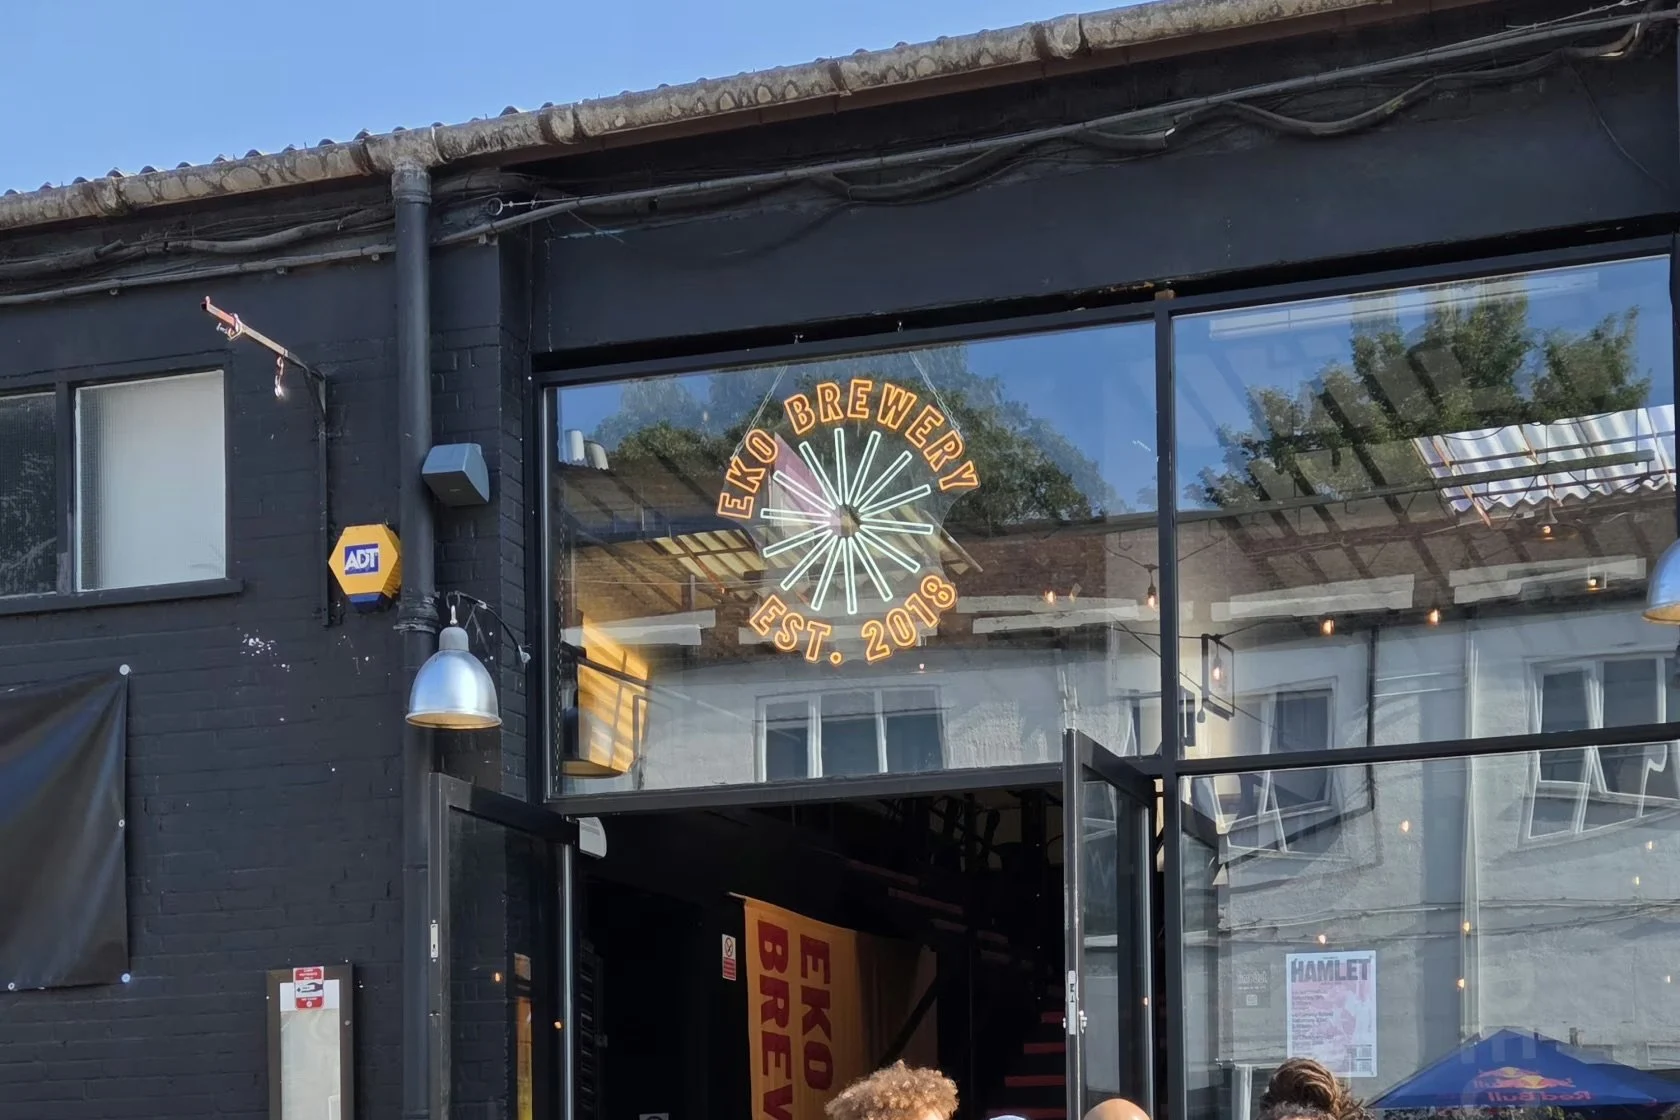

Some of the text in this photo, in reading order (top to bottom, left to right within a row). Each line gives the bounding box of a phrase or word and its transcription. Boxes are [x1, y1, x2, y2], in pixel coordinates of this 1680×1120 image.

[717, 379, 980, 519] EKO BREWERY
[344, 548, 379, 571] ADT
[750, 575, 957, 665] EST. 2018
[799, 933, 834, 1091] EKO
[1290, 958, 1371, 983] HAMLET
